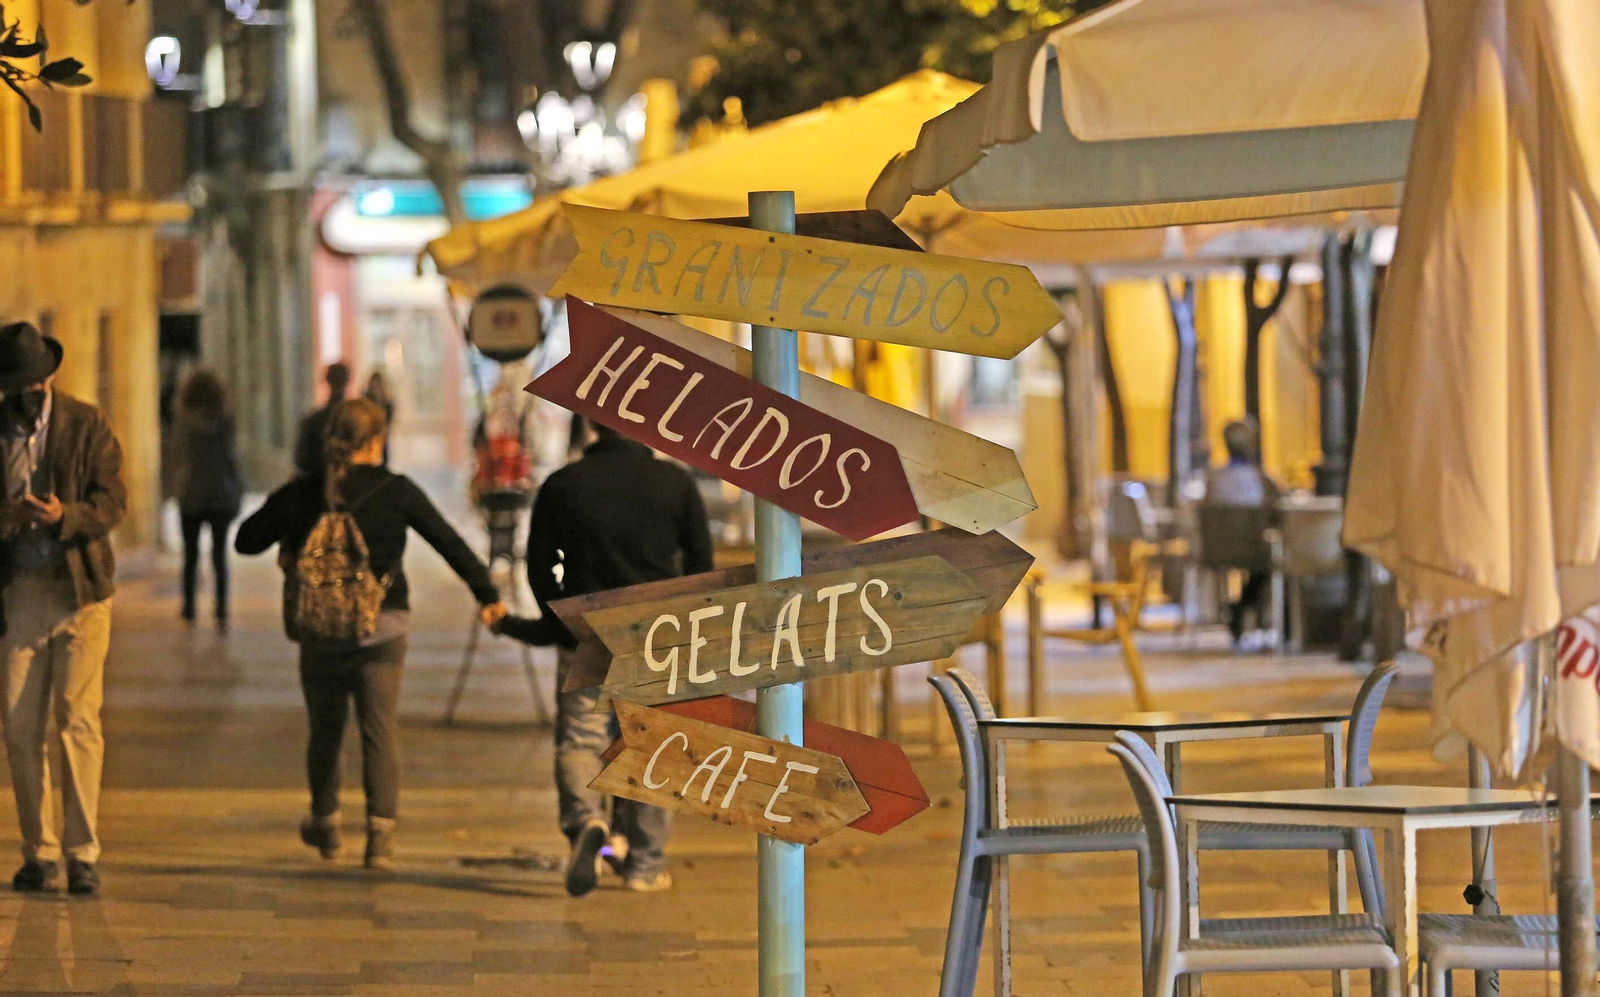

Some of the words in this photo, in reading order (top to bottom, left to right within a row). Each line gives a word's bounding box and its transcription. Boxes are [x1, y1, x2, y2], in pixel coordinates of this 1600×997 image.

[600, 227, 1010, 338] GRANIZADOS
[576, 336, 871, 509] HELADOS
[644, 579, 892, 694] GELATS
[642, 731, 820, 823] CAFE
